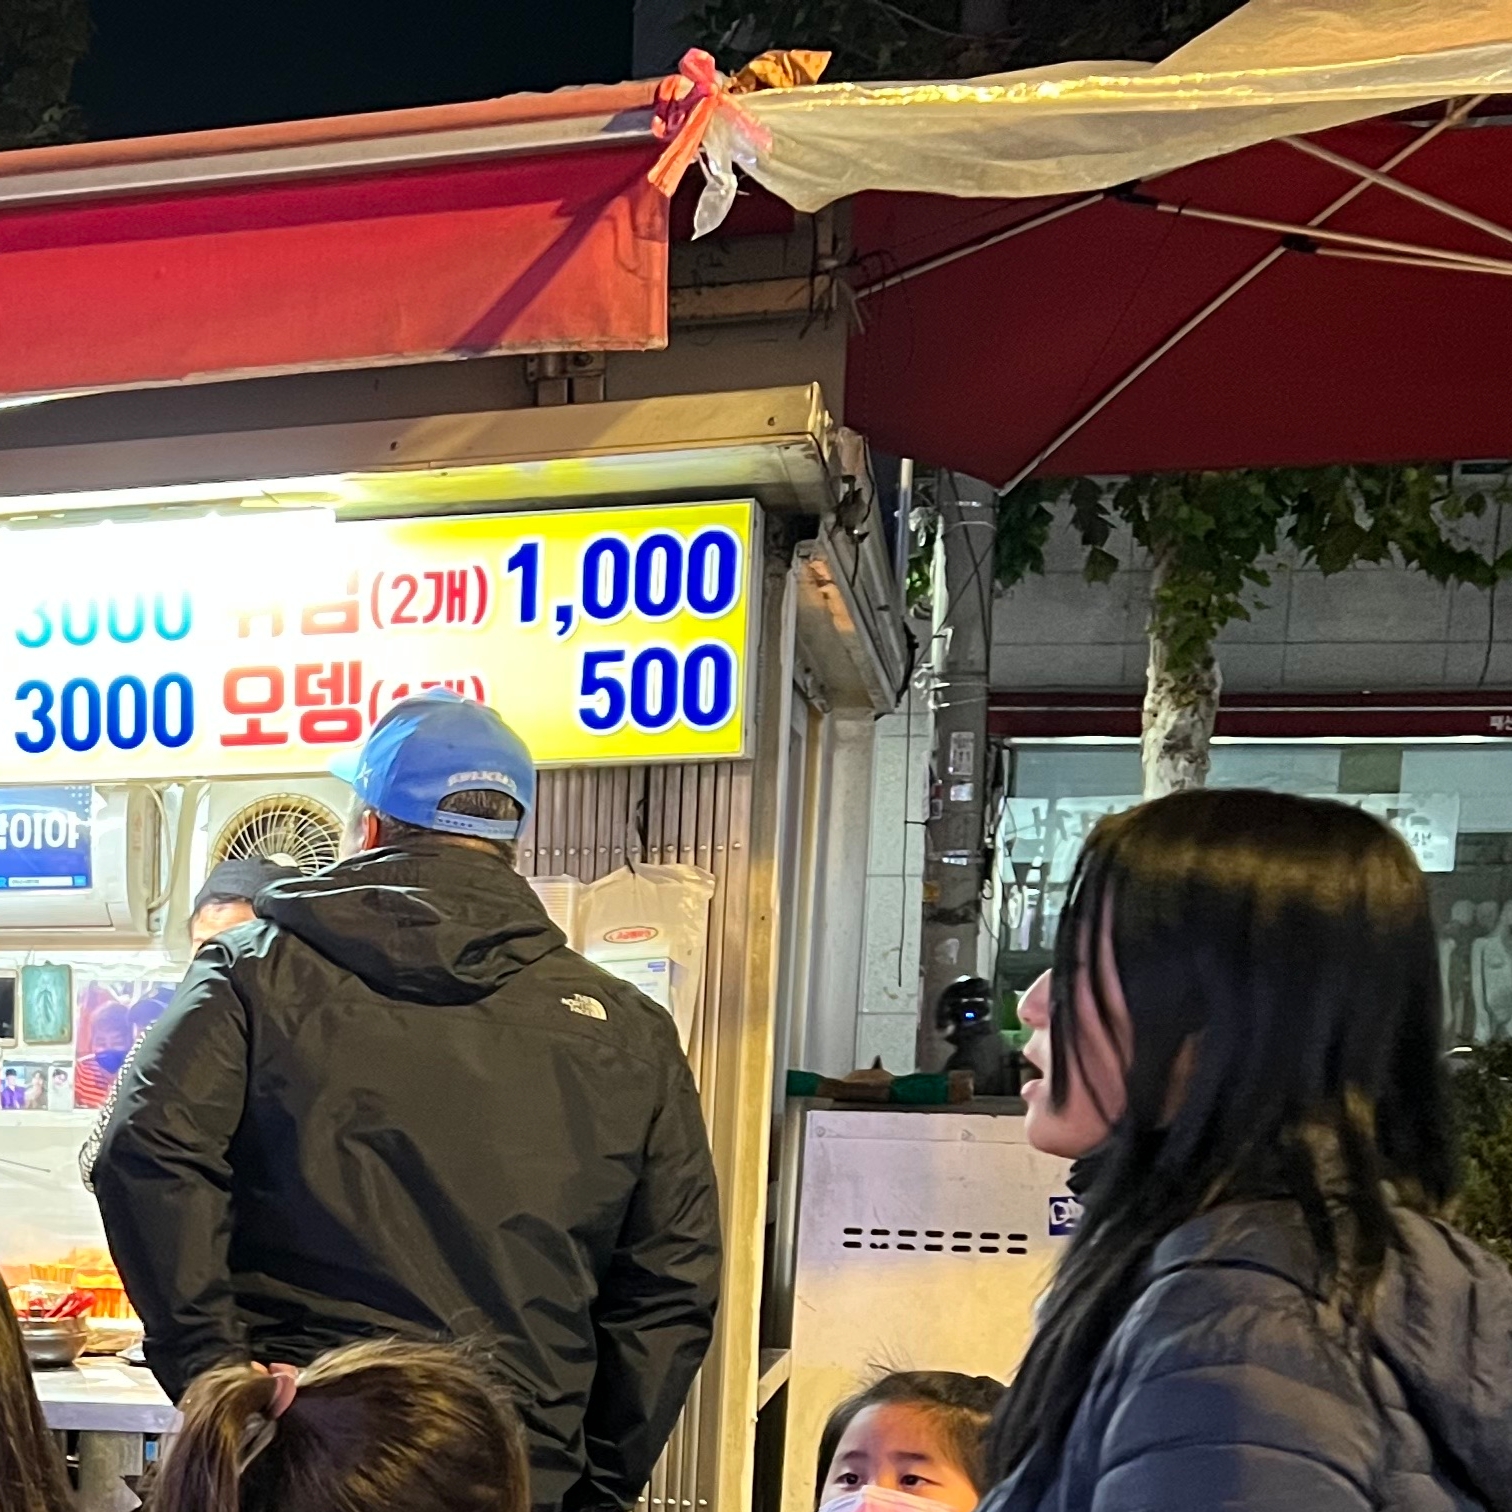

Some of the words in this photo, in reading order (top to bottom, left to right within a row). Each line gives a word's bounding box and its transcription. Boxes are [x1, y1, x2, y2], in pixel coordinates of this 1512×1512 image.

[506, 529, 738, 637] 1,000
[14, 671, 195, 754] 3000
[579, 643, 737, 730] 500
